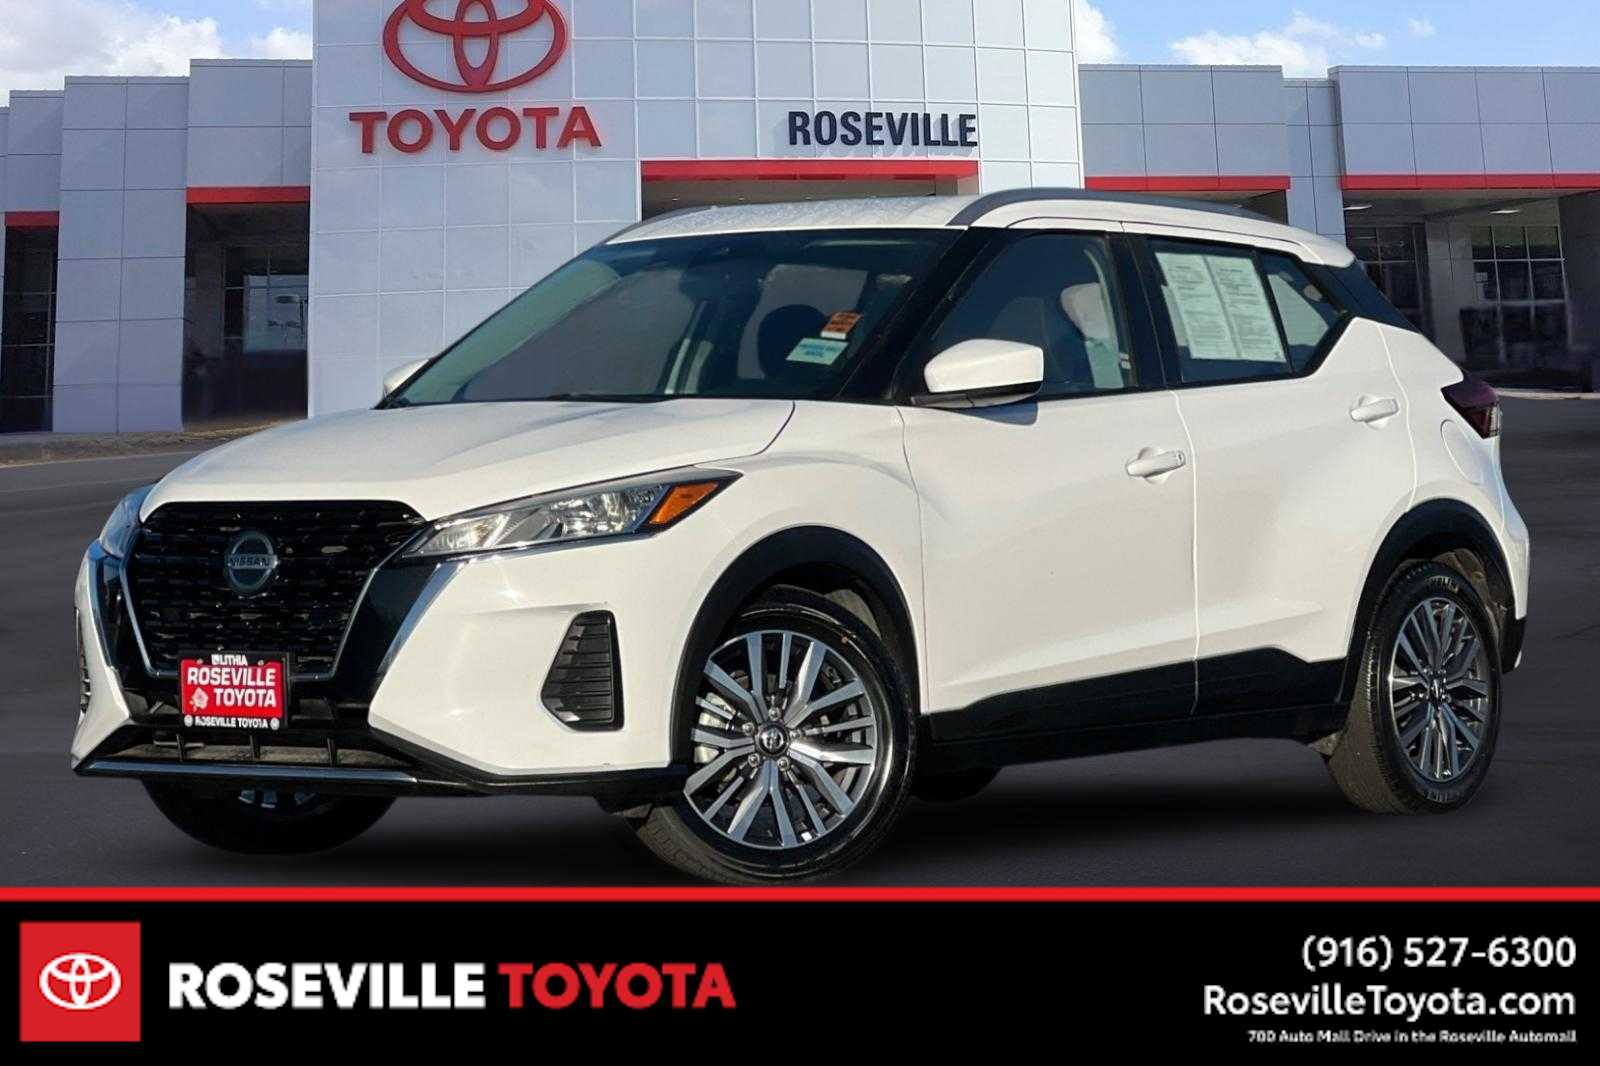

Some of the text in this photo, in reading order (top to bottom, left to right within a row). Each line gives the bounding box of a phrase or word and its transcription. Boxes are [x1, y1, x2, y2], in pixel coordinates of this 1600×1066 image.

[349, 106, 602, 154] TOYOTA
[788, 111, 978, 147] ROSEVILLE
[187, 667, 276, 686] ROSEVILLE
[213, 688, 276, 708] TOYOTA
[195, 716, 269, 729] ROSEVILLE TOYOTA
